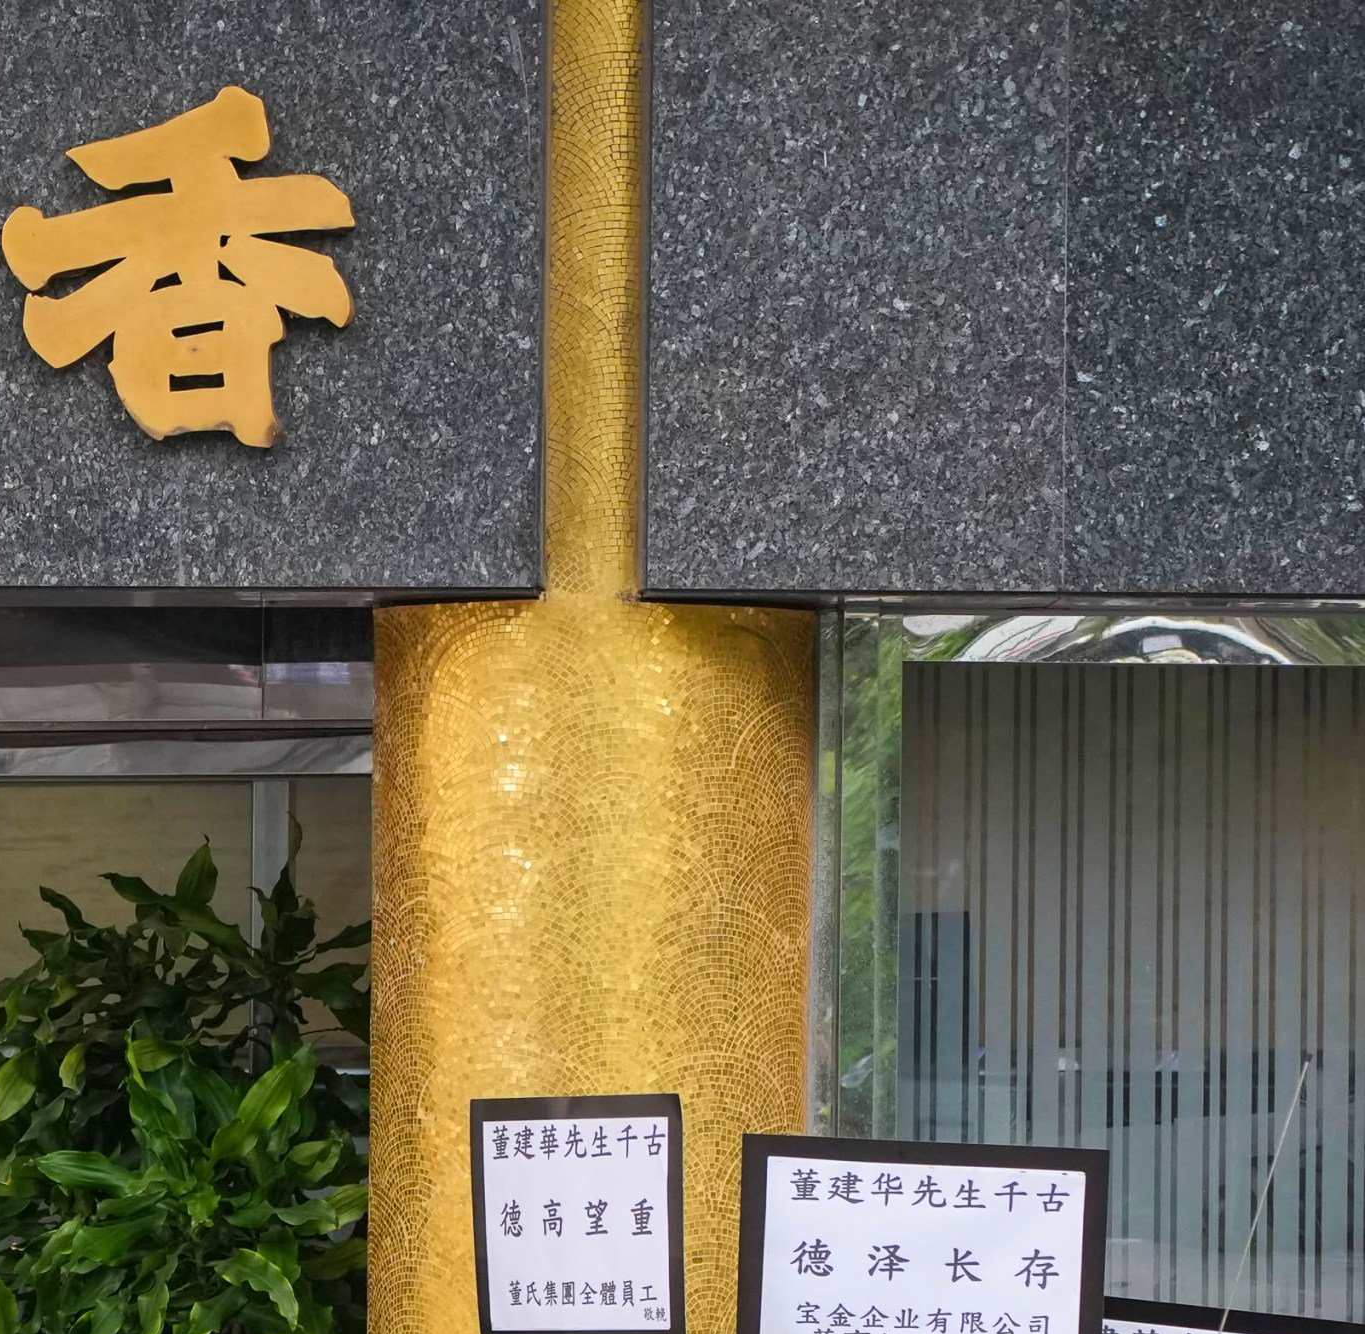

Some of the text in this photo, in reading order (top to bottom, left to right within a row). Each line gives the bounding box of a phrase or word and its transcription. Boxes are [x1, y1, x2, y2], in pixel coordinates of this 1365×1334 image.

[491, 1123, 667, 1160] 董建華先生千古
[789, 1168, 1071, 1213] 董建华先生千古
[499, 1198, 655, 1238] 德高望重
[789, 1238, 1061, 1290] 德泽长存
[508, 1280, 659, 1307] 董氏集團全體員工
[643, 1307, 668, 1322] 敬輓
